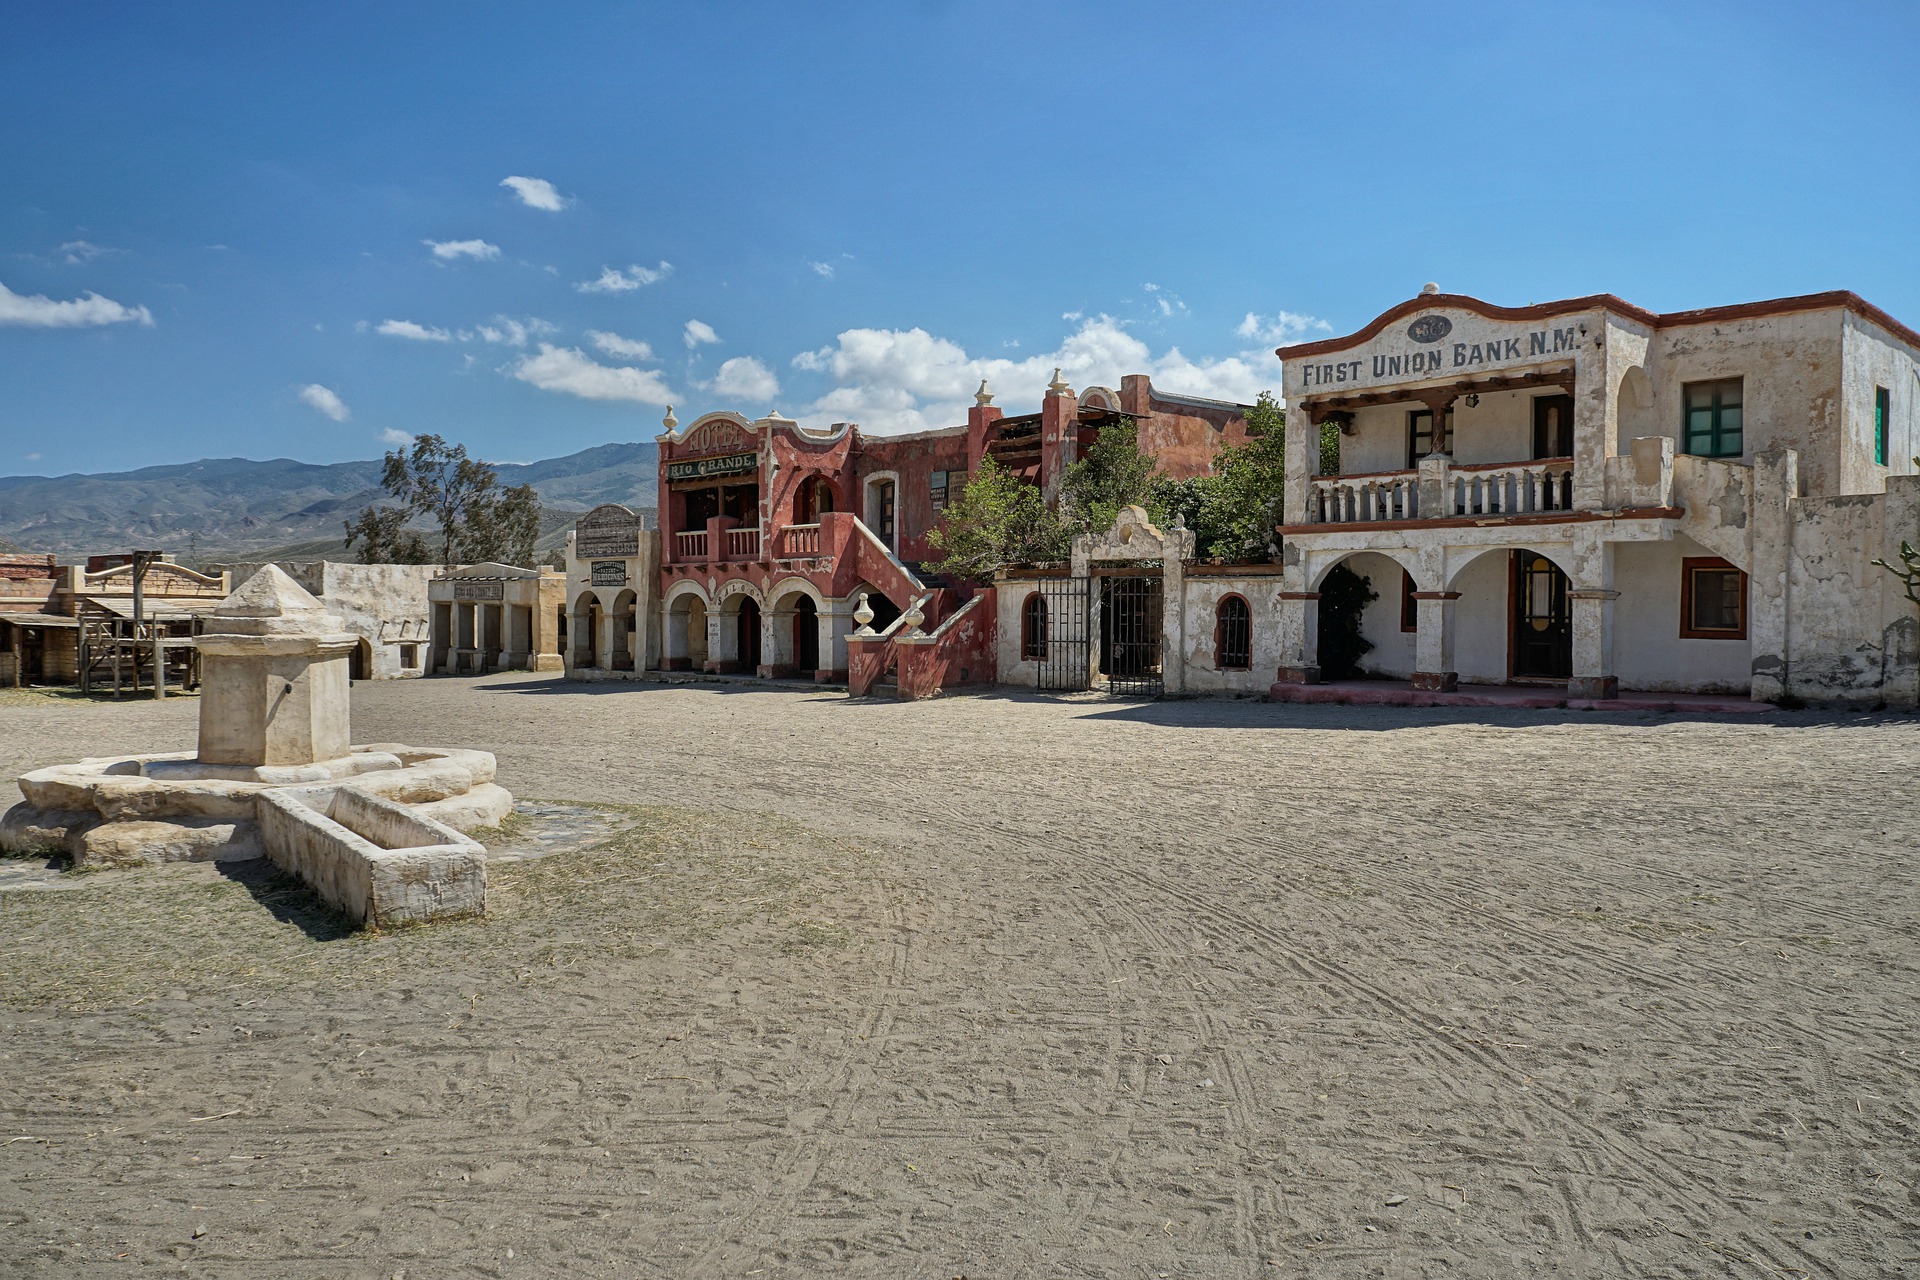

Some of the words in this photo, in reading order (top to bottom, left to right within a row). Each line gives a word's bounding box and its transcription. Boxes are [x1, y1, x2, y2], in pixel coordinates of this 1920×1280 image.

[1302, 361, 1362, 386] FIRST
[1373, 349, 1442, 378] UNION
[1453, 337, 1521, 367] BANK
[1529, 327, 1581, 356] N.M.
[688, 421, 743, 452] HOTEL
[670, 465, 693, 477] RIO
